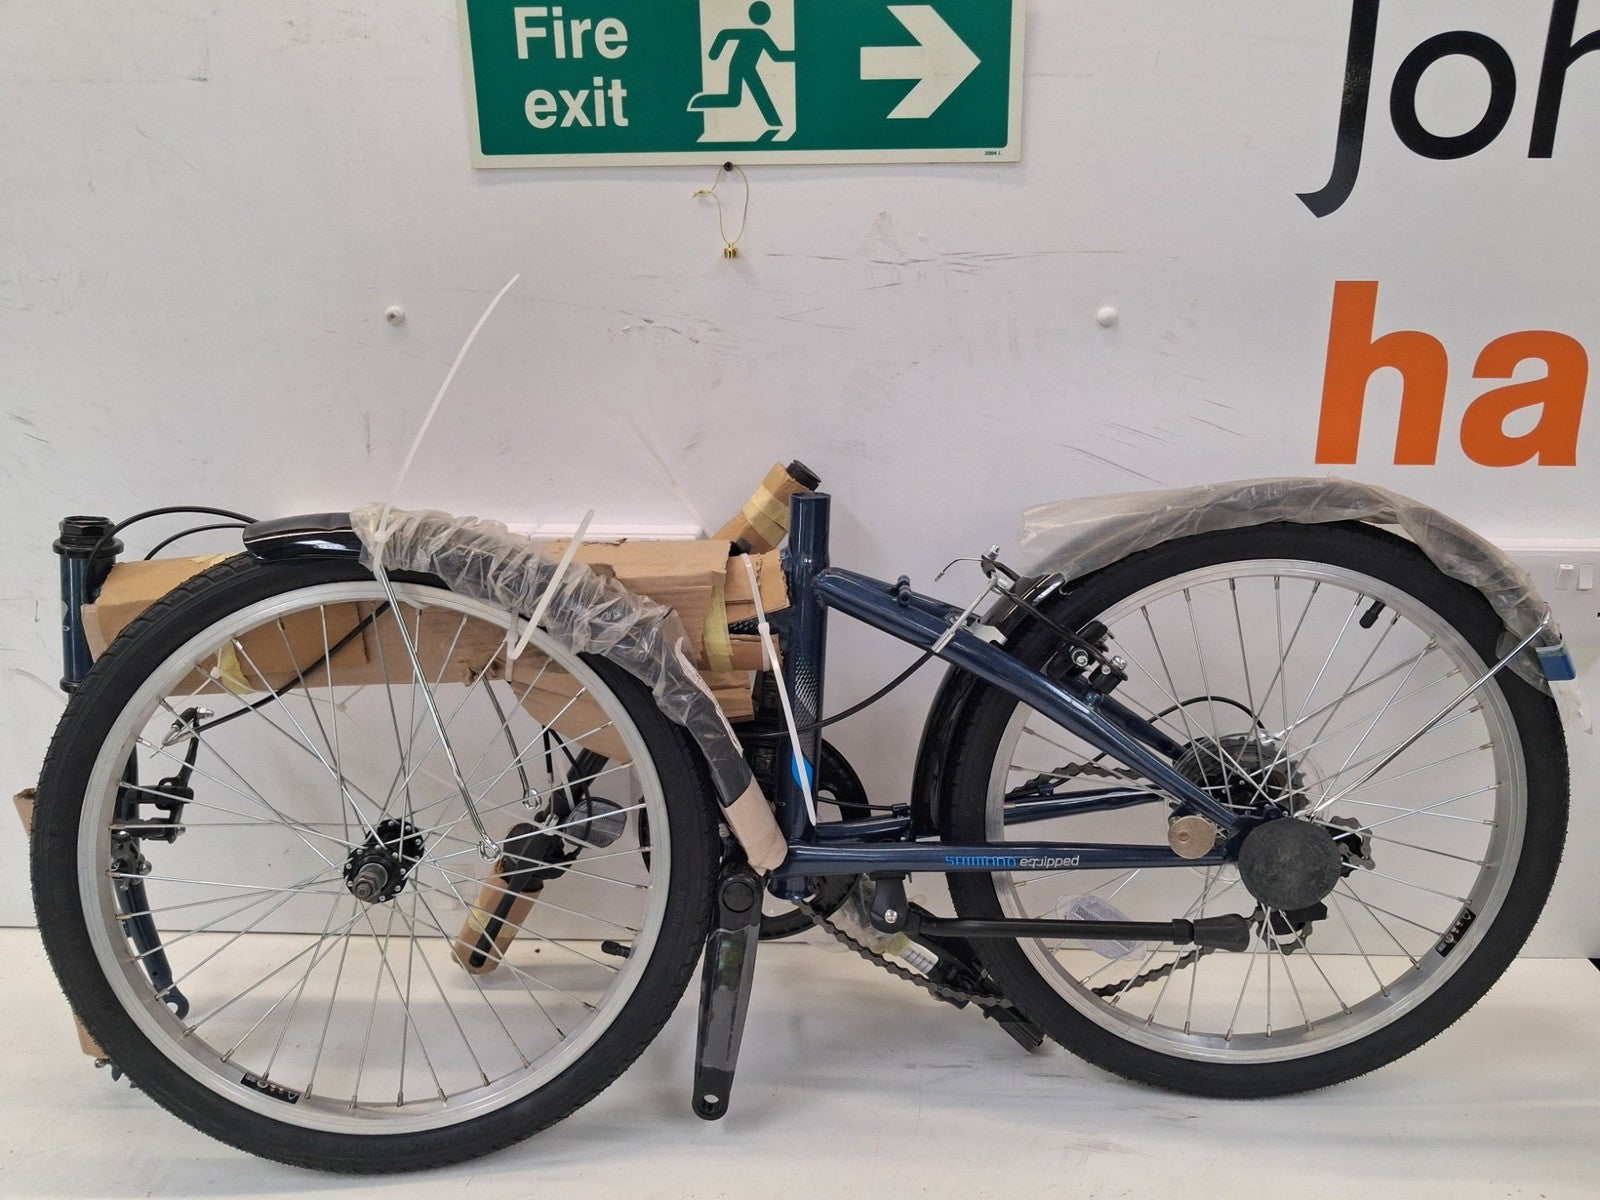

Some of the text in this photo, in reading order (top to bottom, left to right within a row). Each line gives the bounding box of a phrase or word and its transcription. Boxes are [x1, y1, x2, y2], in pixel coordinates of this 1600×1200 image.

[514, 6, 629, 60] Fire
[525, 77, 629, 129] exit
[1315, 280, 1589, 468] ha
[944, 855, 1080, 868] SHIMANO equipped
